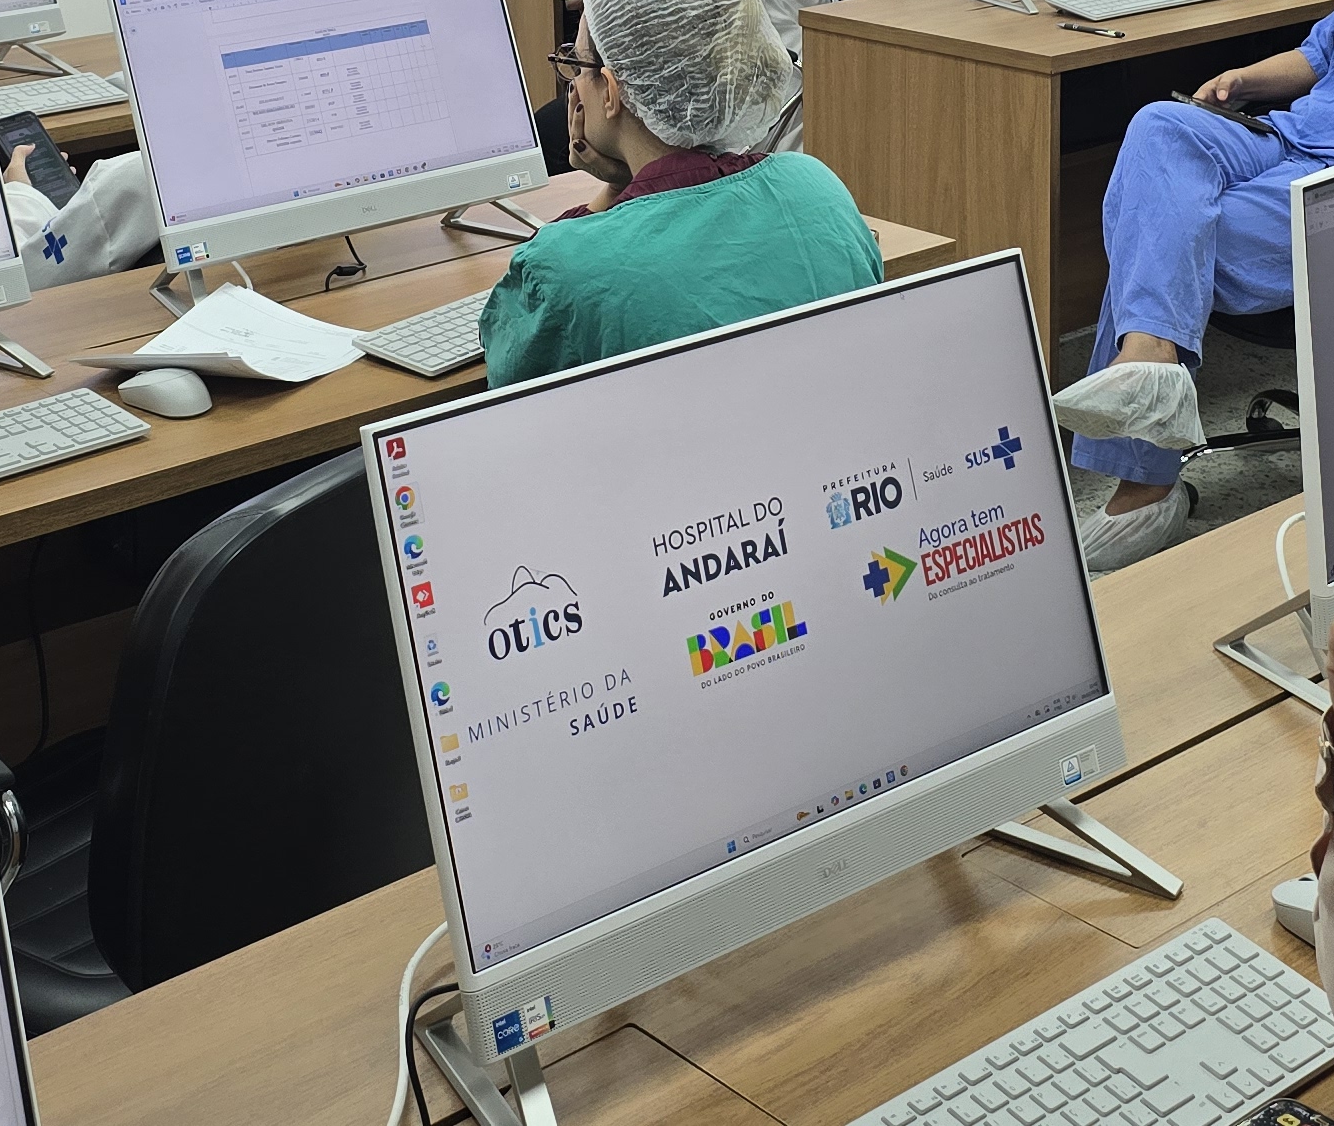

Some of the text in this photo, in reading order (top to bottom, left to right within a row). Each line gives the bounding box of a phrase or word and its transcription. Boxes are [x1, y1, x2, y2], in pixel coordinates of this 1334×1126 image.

[822, 462, 896, 493] PREFEITURA
[850, 448, 991, 521] RIO Saúde SUS
[653, 497, 783, 556] HOSPITAL DO
[919, 504, 1005, 549] Agora tem
[921, 513, 1045, 586] ESPECIALISTAS
[663, 517, 788, 597] ANDARAÍ
[928, 563, 1014, 601] Da consulta ao tratamento
[488, 601, 582, 660] otics
[709, 591, 774, 621] GOVERNO DO
[686, 601, 807, 677] BRASIL
[701, 644, 805, 689] DO LADO DO POVO BRASILEIRO
[468, 668, 631, 743] MINISTÉRIO DA
[570, 696, 637, 736] SAÚDE
